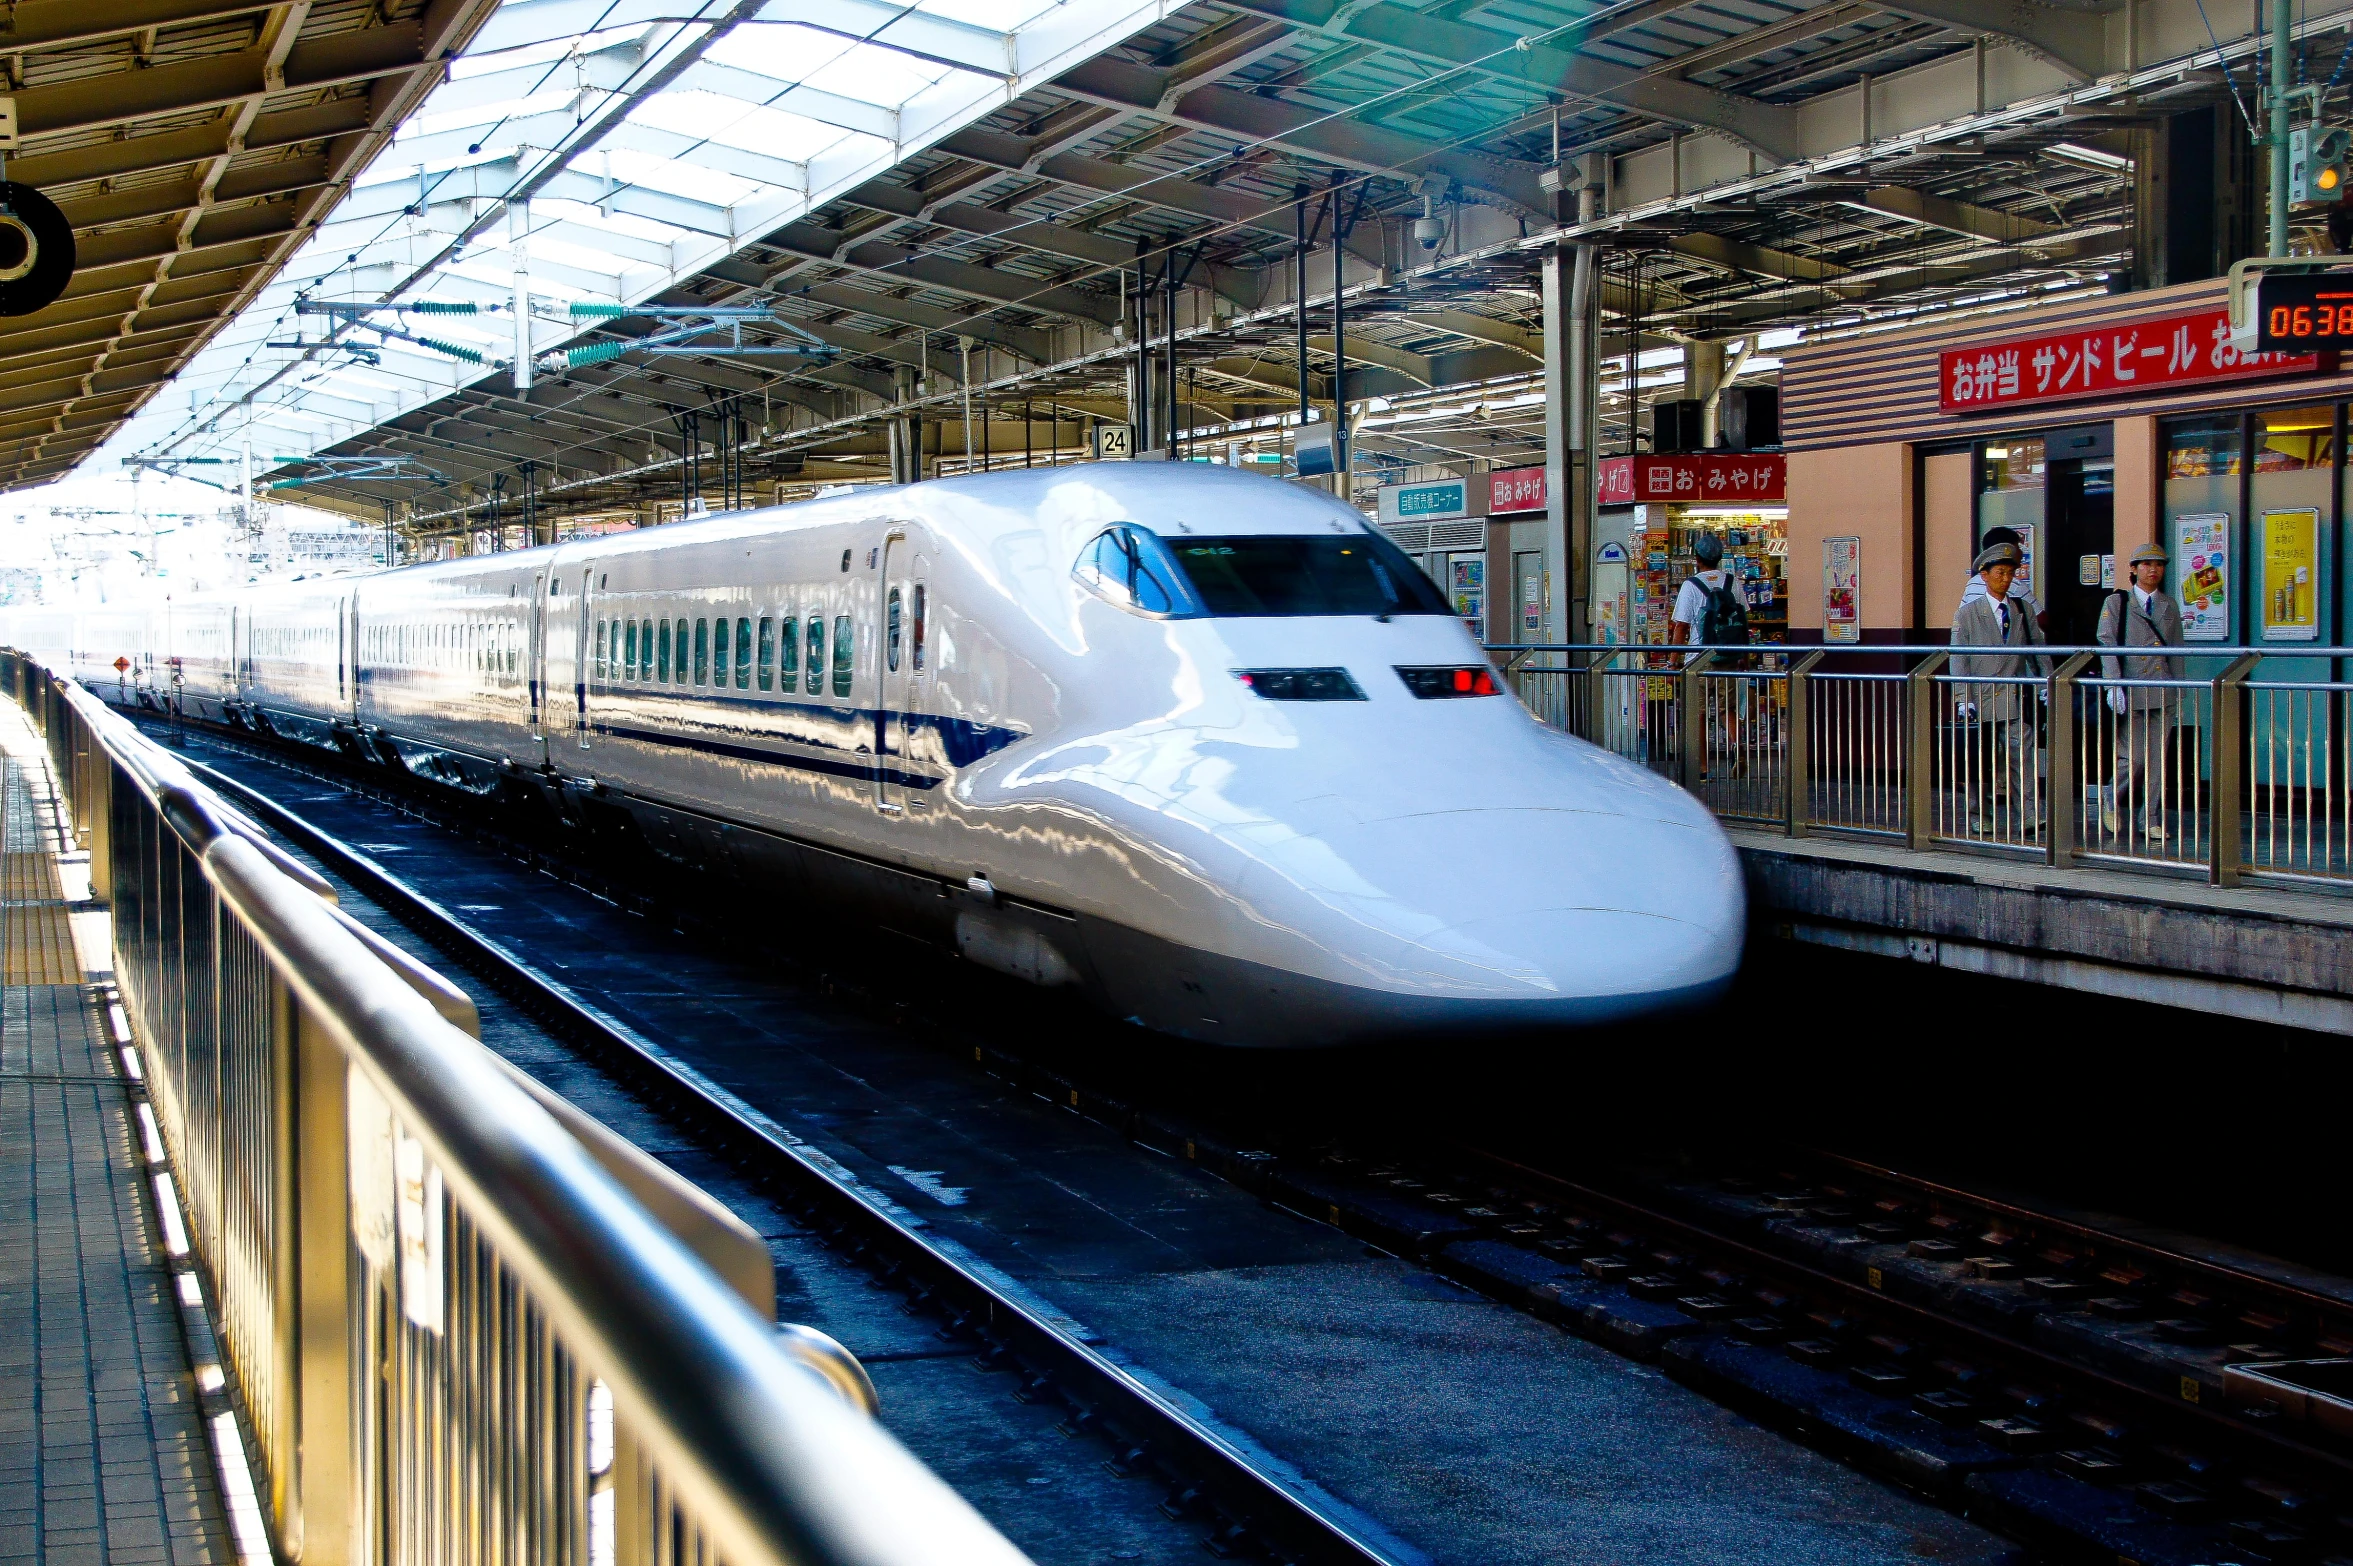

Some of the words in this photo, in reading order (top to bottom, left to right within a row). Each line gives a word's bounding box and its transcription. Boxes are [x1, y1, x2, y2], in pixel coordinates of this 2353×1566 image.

[1952, 350, 2020, 402] お弁当
[2031, 338, 2102, 393] サンド
[2113, 325, 2198, 382] ビール
[1104, 431, 1126, 452] 24
[1337, 430, 1347, 440] 13
[1504, 477, 1541, 503] おみやげ
[1676, 466, 1772, 491] おみやげ
[1401, 490, 1459, 511] 自動販売機コーナー
